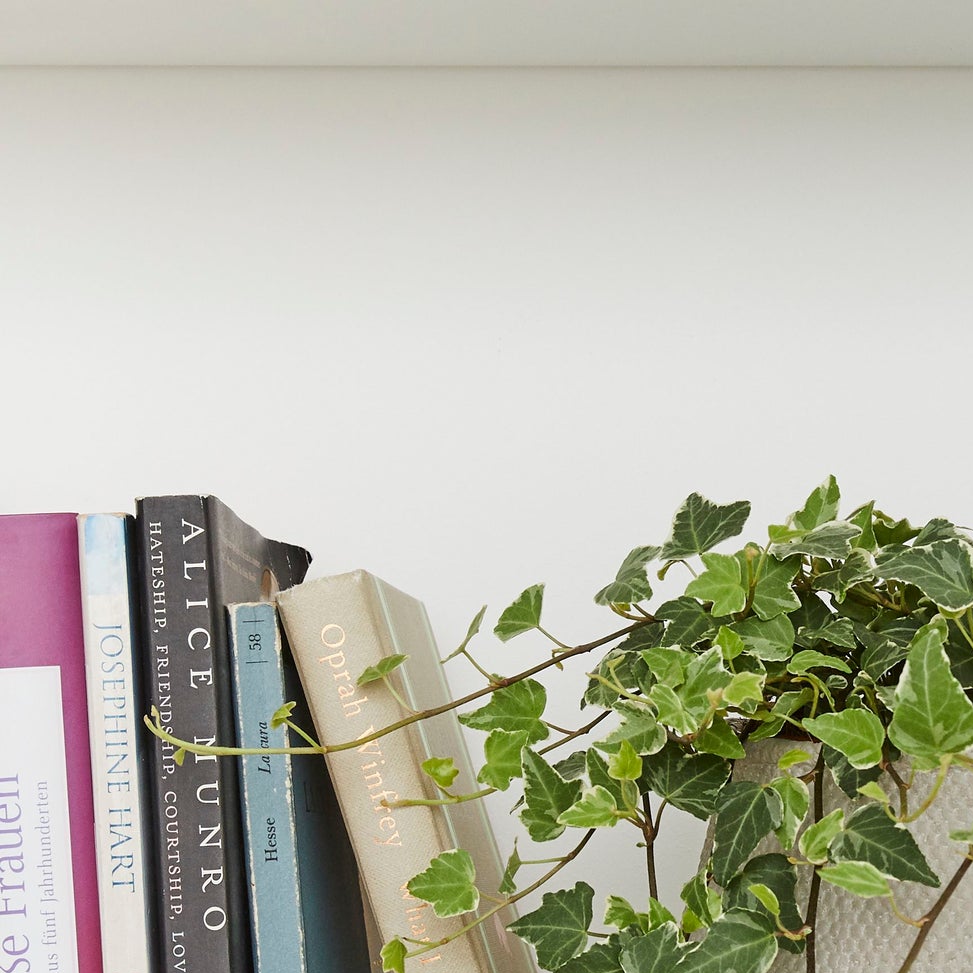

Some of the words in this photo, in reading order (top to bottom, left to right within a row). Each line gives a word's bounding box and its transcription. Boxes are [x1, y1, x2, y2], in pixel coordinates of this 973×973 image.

[149, 521, 168, 634] HATESHIP,
[181, 518, 214, 690] ALICE
[249, 632, 262, 652] 58
[93, 624, 131, 794] JOSEPHINE
[156, 645, 176, 781] FRIENDSHIP,
[258, 755, 272, 775] La
[259, 721, 270, 750] cura
[319, 623, 368, 718] Oprah
[355, 725, 402, 847] Winfrey
[0, 774, 27, 918] Frauen
[35, 781, 59, 902] Jahrhunderten
[108, 807, 136, 893] HART
[164, 791, 184, 920] COURTSHIP,
[193, 734, 227, 931] MUNRO
[264, 816, 279, 863] Hesse
[40, 910, 57, 945] fünf
[420, 952, 442, 966] I
